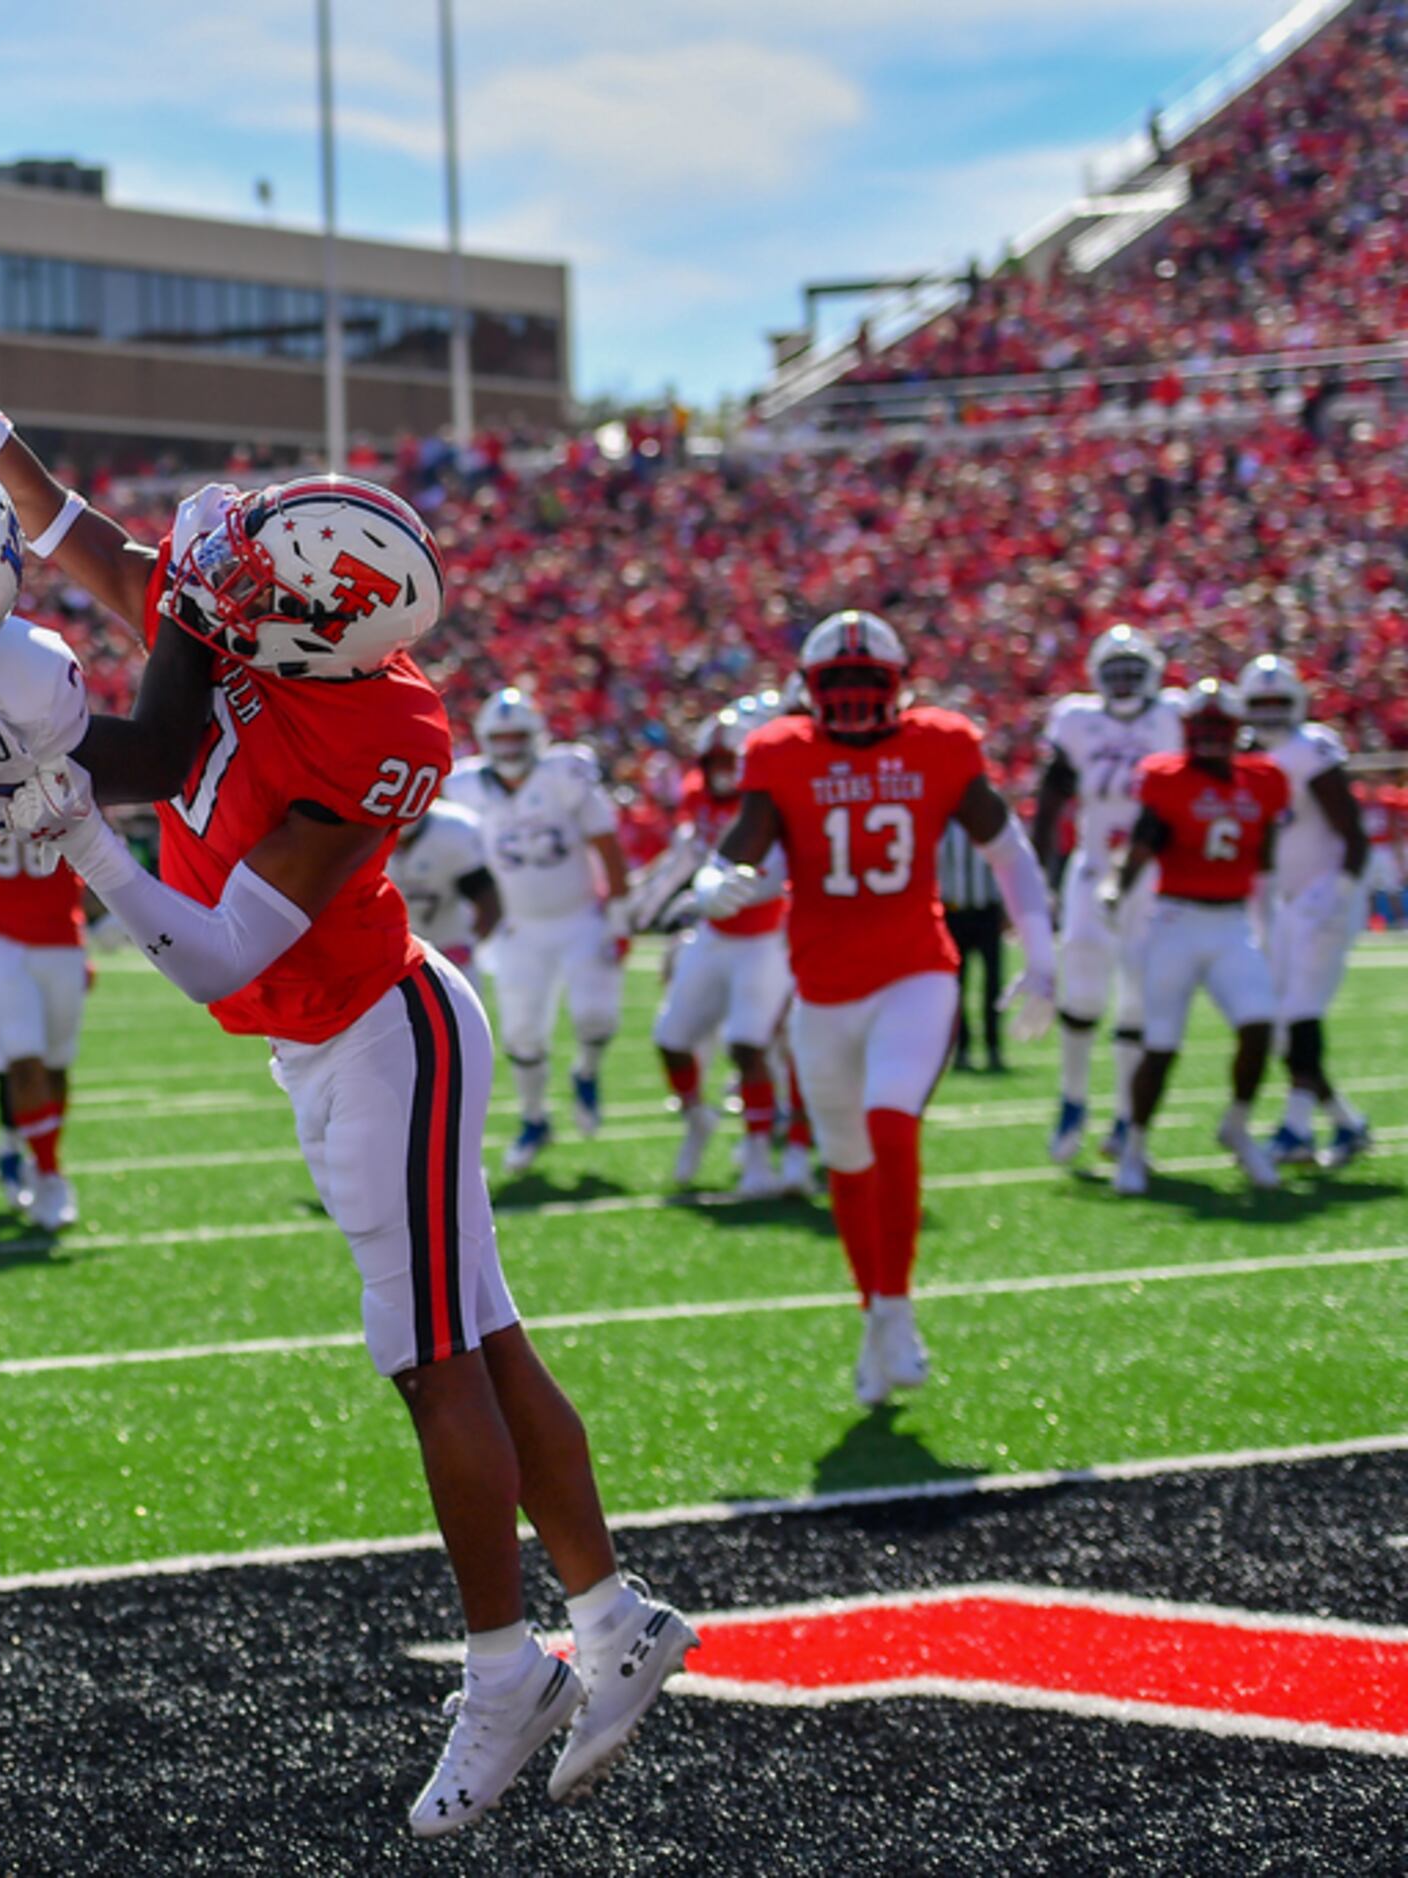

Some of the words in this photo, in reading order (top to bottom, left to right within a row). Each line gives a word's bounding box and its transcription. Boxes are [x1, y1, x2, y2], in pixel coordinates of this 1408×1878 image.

[361, 757, 440, 820] 20
[811, 774, 873, 805] TEXAS
[878, 771, 925, 800] TECH
[822, 803, 914, 898] 13
